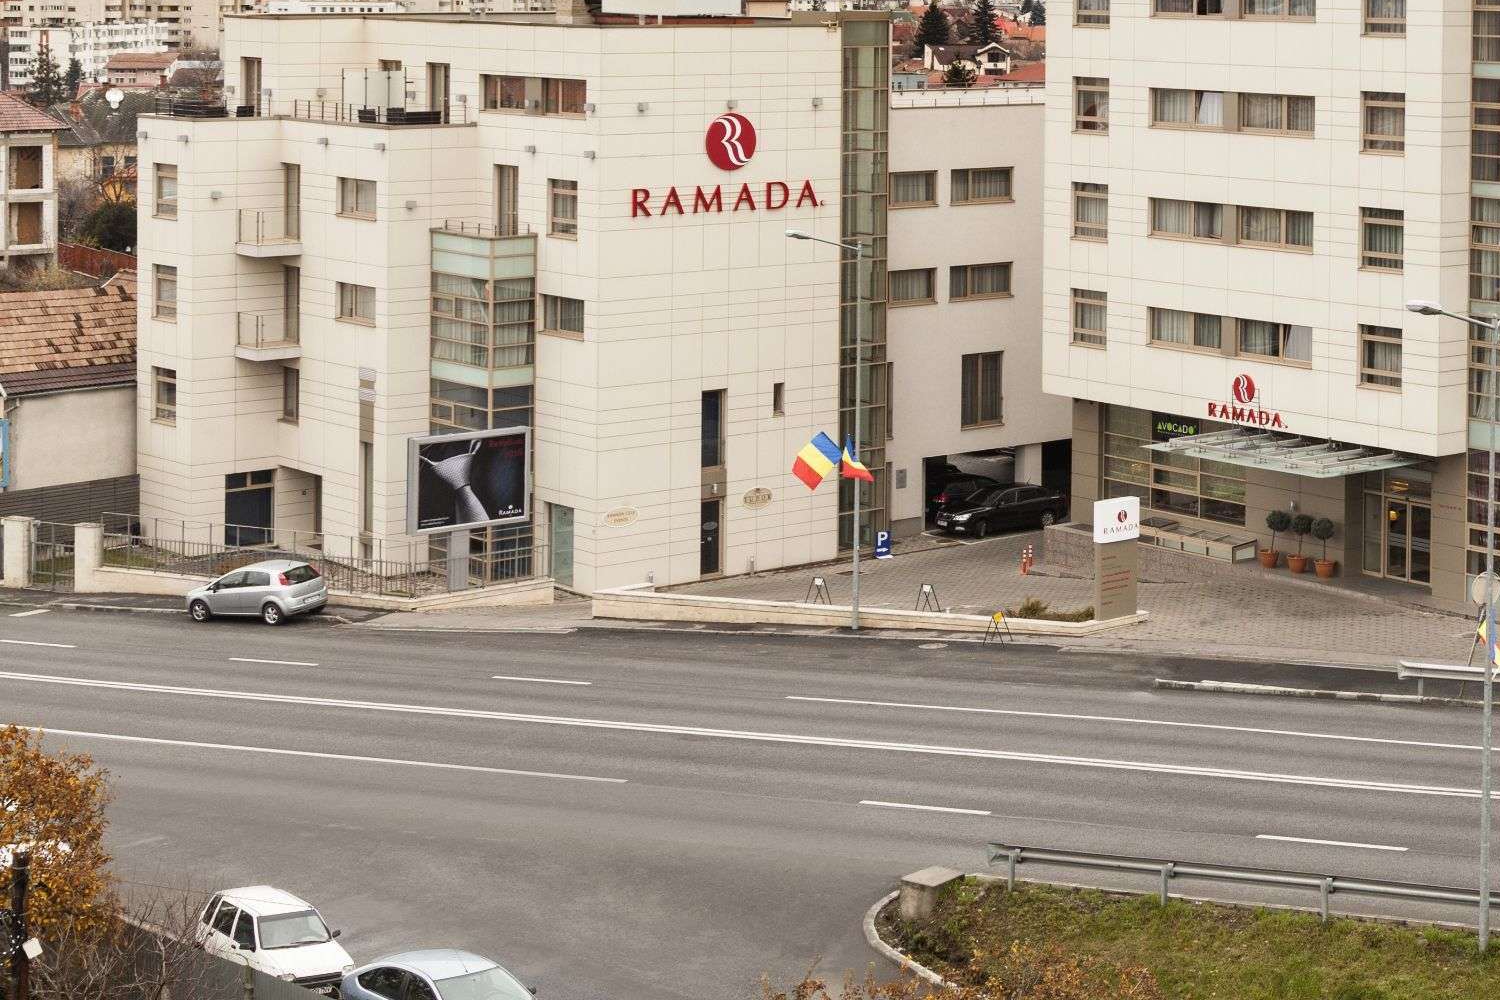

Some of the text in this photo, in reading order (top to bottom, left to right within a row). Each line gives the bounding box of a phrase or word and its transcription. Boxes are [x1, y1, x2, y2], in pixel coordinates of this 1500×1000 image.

[631, 179, 818, 218] RAMADA
[1207, 402, 1282, 429] RAMADA
[1157, 421, 1195, 435] AVOCADO
[498, 508, 522, 516] RAMADA
[1103, 522, 1138, 535] RAMADA
[877, 531, 889, 546] P
